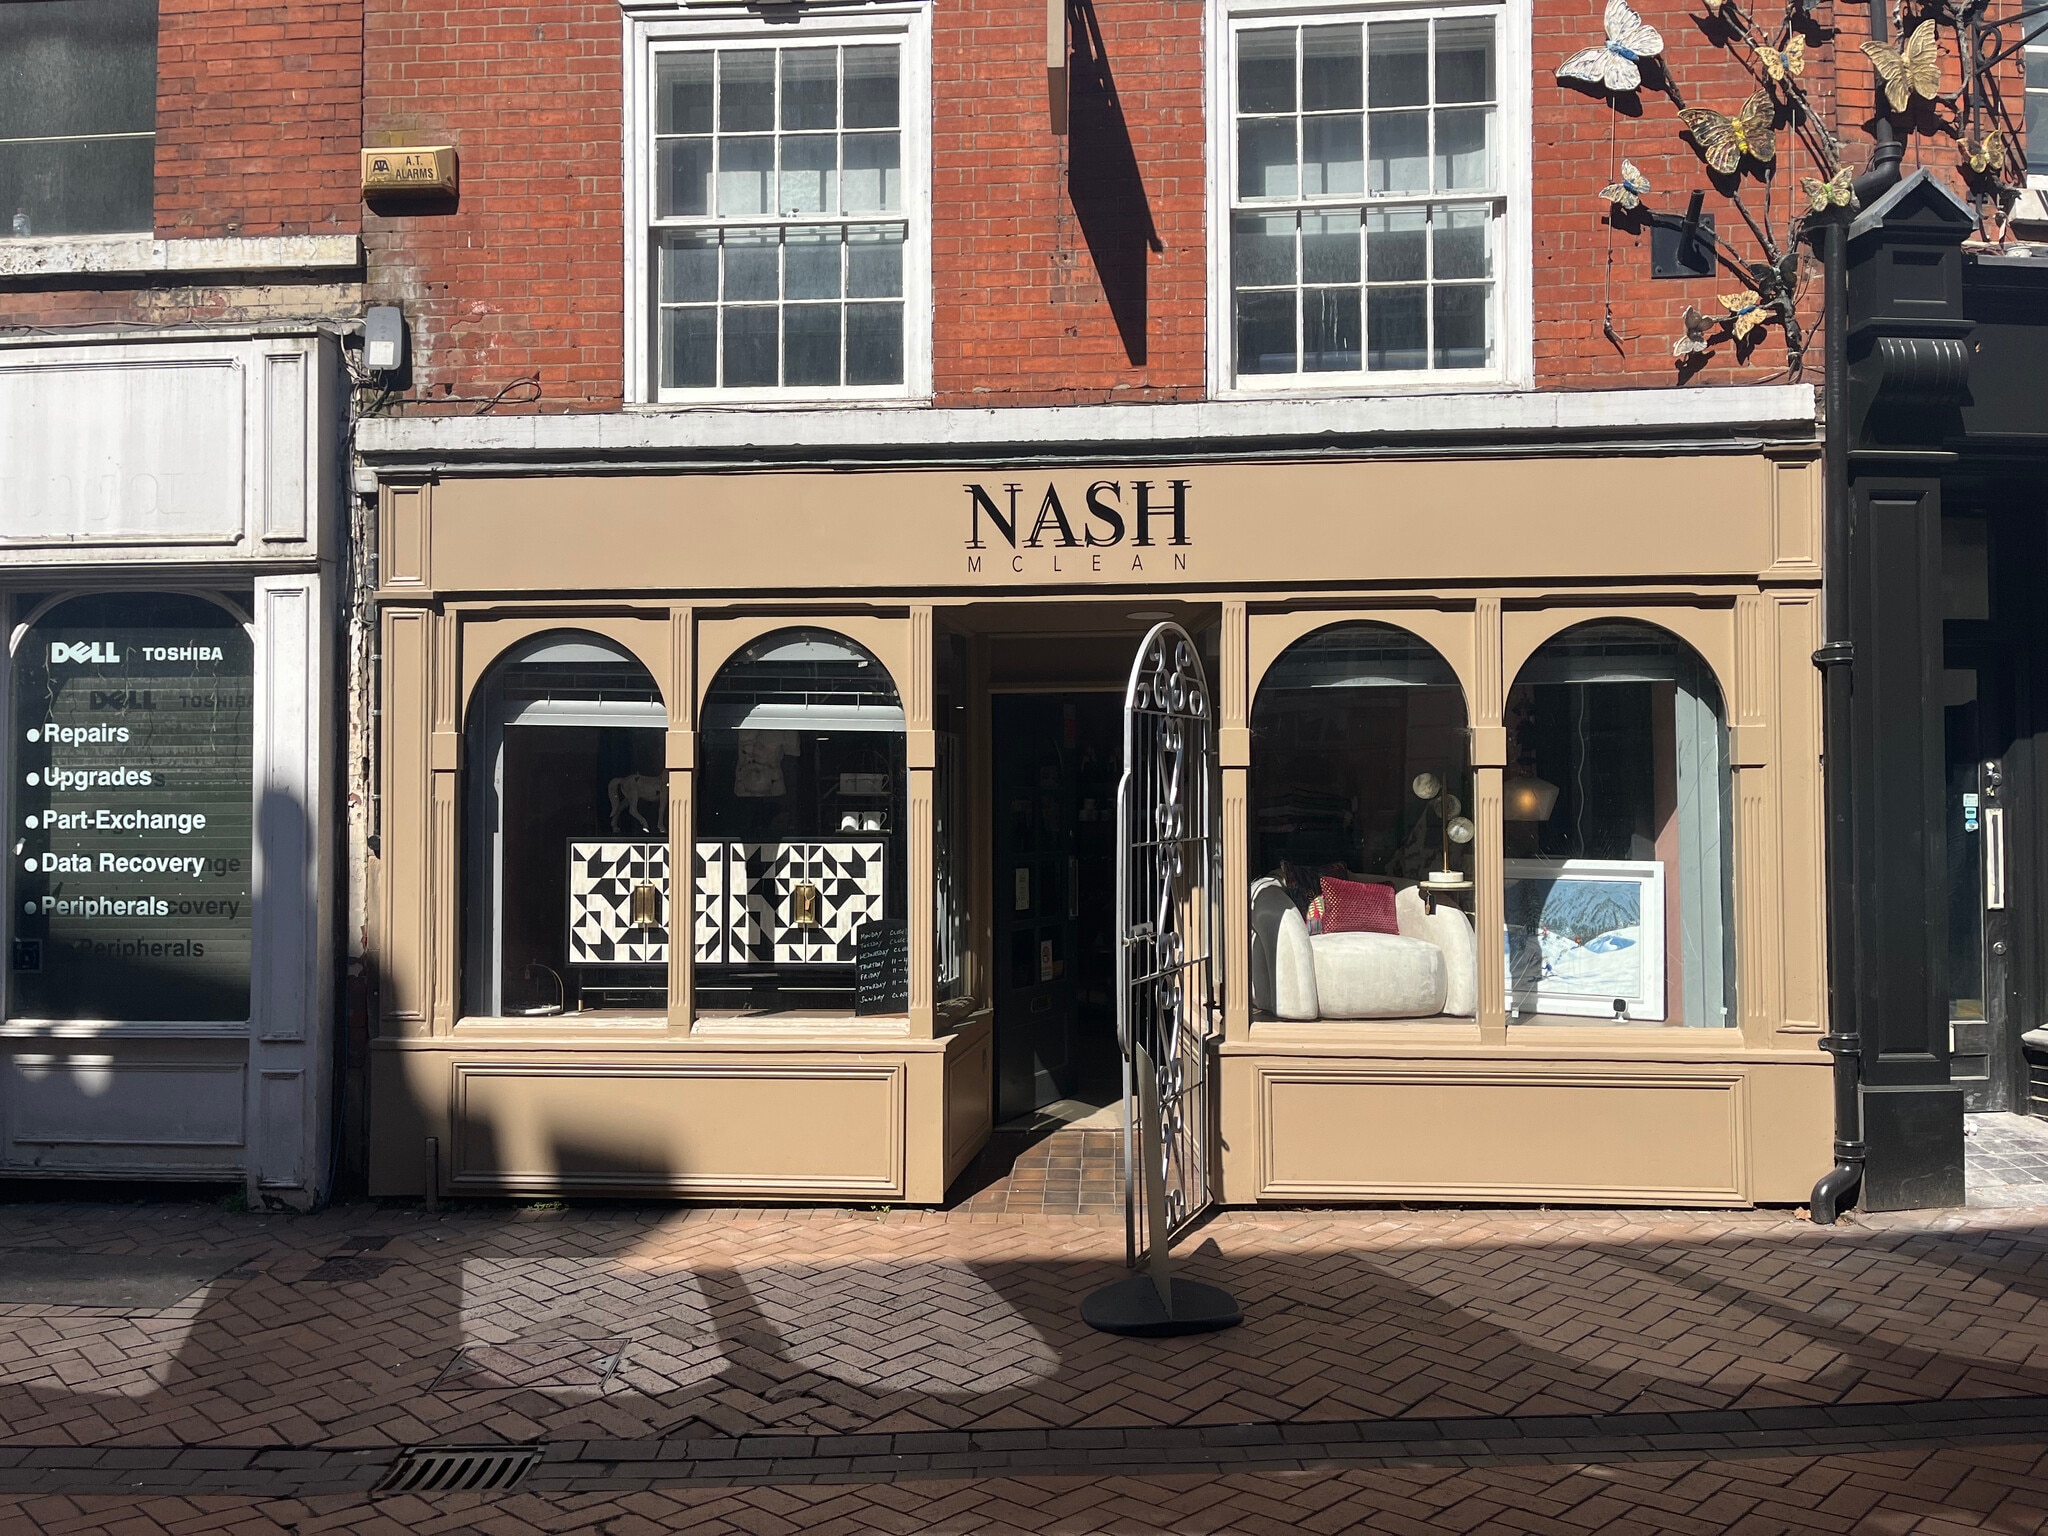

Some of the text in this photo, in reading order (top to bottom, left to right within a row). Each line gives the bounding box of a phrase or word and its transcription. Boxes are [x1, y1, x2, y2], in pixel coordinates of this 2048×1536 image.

[406, 155, 423, 166] A.T.
[396, 168, 434, 179] ALARMS
[962, 479, 1192, 549] NASH
[967, 553, 1186, 573] MCLEAN
[51, 641, 120, 664] DELL
[142, 647, 224, 661] TOSHIBA
[44, 723, 130, 747] Repairs
[43, 767, 152, 791] Upgrades
[42, 810, 207, 834] Part-Exchange
[41, 853, 92, 872] Data
[99, 853, 206, 877] Recovery
[41, 896, 169, 920] Peripherals
[860, 971, 881, 981] FRIDAY
